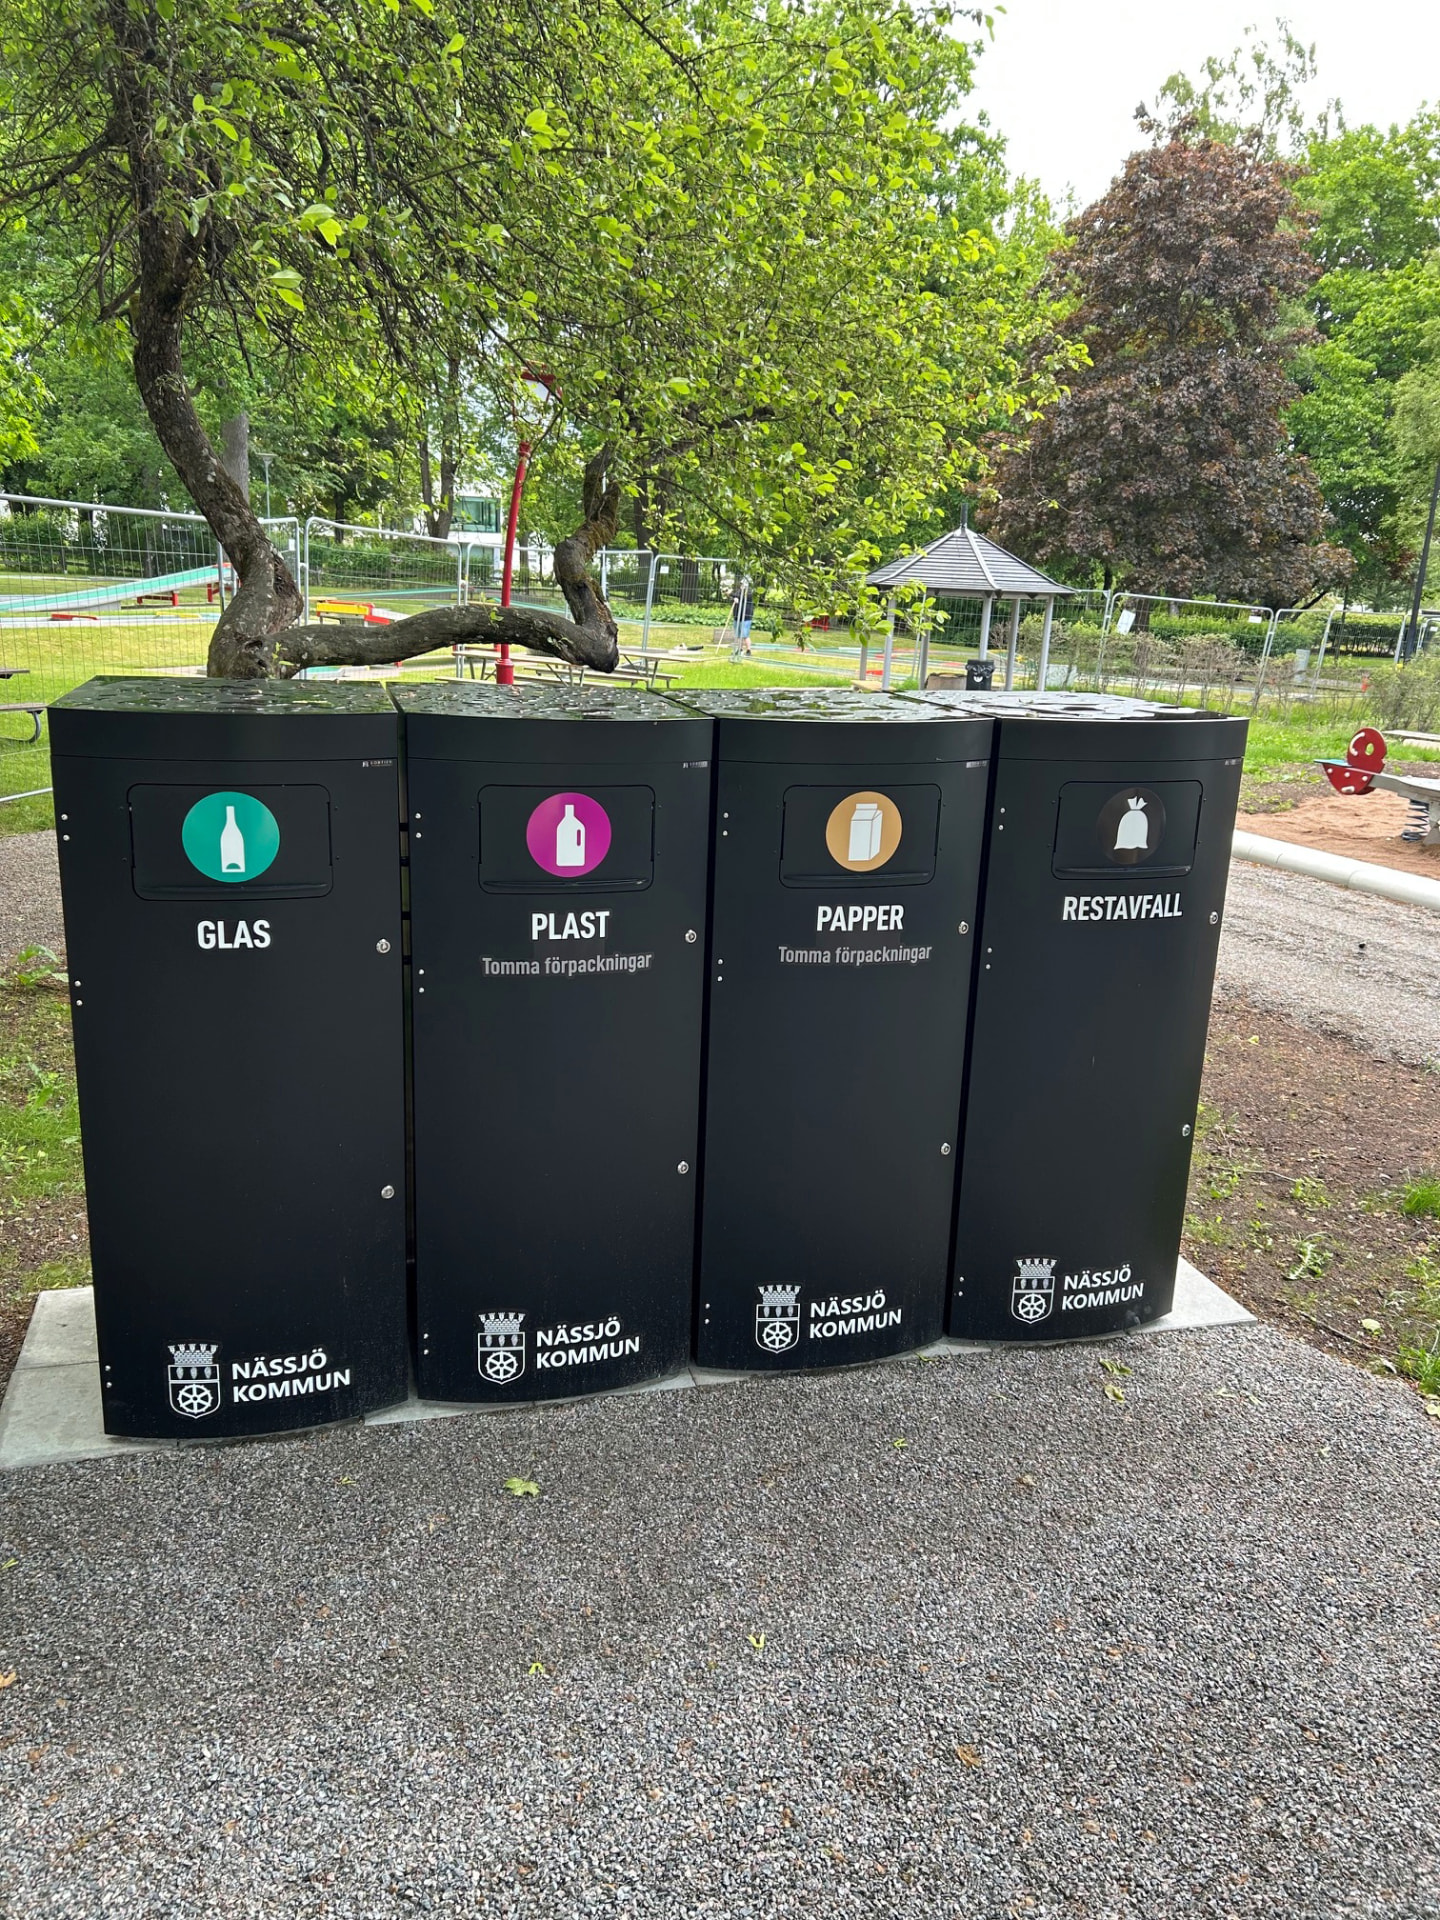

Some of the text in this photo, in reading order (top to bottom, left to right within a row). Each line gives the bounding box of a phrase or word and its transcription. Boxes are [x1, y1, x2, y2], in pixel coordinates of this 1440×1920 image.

[816, 904, 904, 932] PAPPER
[1062, 892, 1183, 921] RESTAVFALL
[197, 919, 271, 950] GLAS
[531, 910, 610, 941] PLAST
[481, 952, 653, 977] Tomma förpackningar
[778, 944, 933, 967] Tomma förpackningar
[1063, 1263, 1132, 1291] NÄSSJÖ
[810, 1288, 886, 1318] NÄSSJÖ
[1061, 1282, 1144, 1311] KOMMUN
[536, 1316, 621, 1348] NÄSSJÖ
[809, 1308, 902, 1339] KOMMUN
[231, 1347, 327, 1380] NÄSSJÖ
[536, 1335, 640, 1369] KOMMUN
[232, 1368, 351, 1403] KOMMUN
